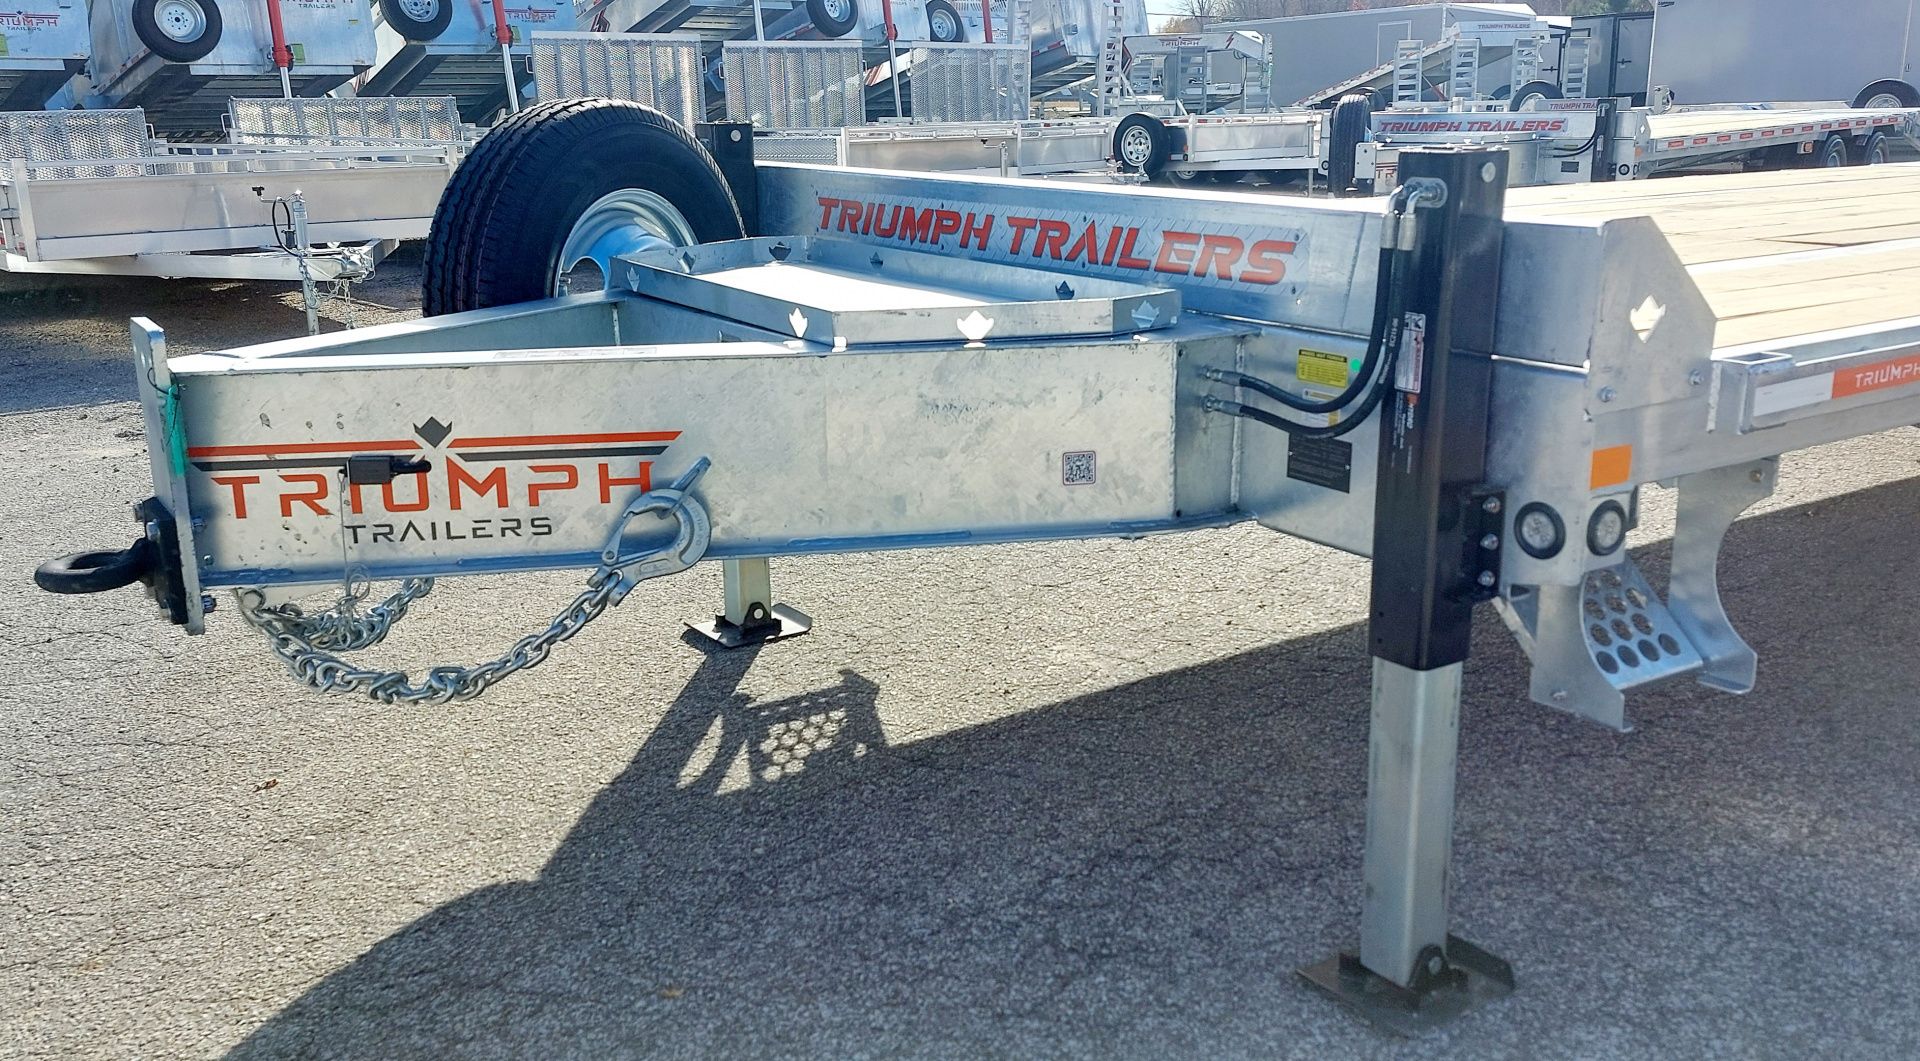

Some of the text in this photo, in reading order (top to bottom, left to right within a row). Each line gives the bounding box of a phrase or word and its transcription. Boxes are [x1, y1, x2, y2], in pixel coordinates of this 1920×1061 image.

[0, 17, 58, 27] RIUMPH
[1549, 102, 1582, 110] TRIUMPH
[1381, 120, 1566, 132] TRIUMPH TRAILERS
[1376, 169, 1397, 179] TR
[817, 196, 1298, 286] TRIUMPH TRAILERS
[1855, 362, 1920, 388] TRIUMPH
[211, 455, 655, 519] TRIUMPH
[343, 516, 553, 545] TRAILERS
